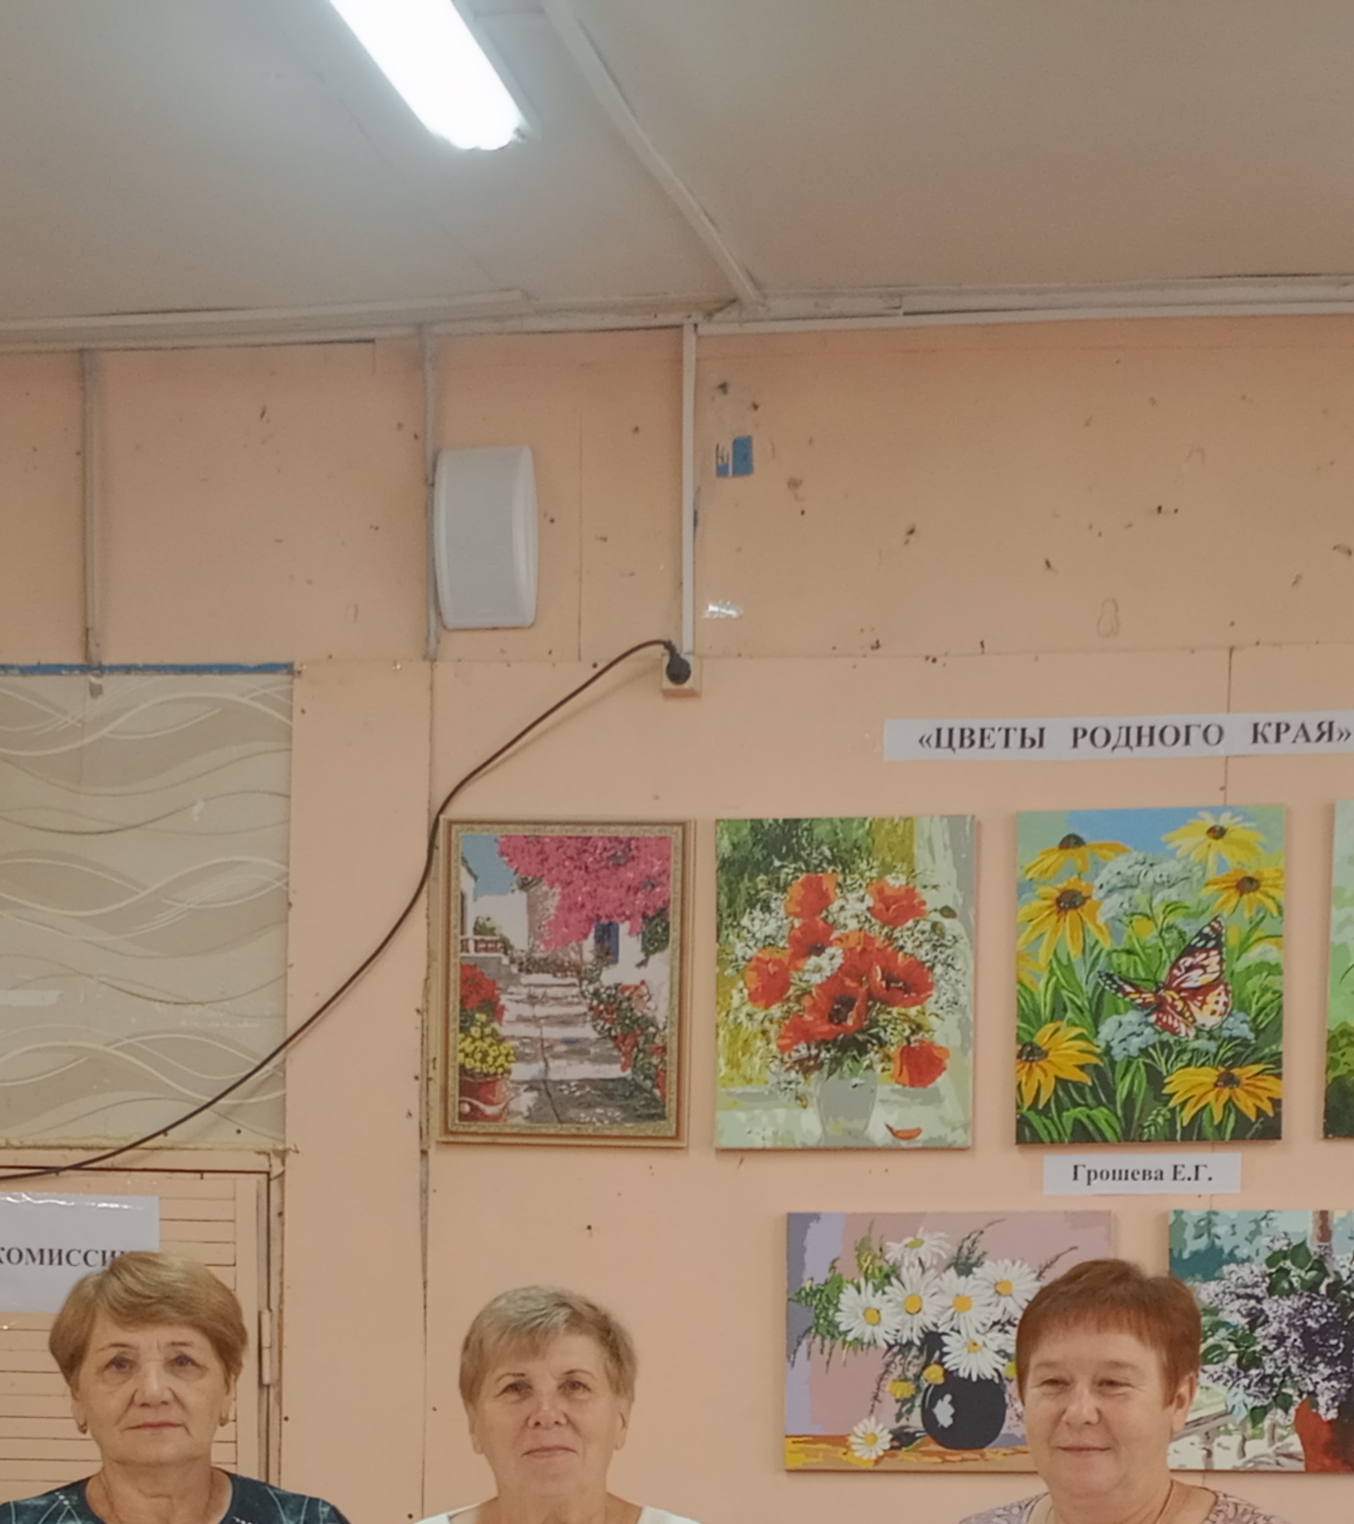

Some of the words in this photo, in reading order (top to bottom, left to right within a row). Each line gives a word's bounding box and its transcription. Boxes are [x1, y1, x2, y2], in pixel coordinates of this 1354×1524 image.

[918, 726, 1045, 753] «ЦВЕТЫ
[1070, 723, 1226, 753] РОДНОГО
[1250, 720, 1353, 746] КРАЯ»
[1072, 1163, 1165, 1186] Грошева
[1171, 1163, 1214, 1182] Е.Г.
